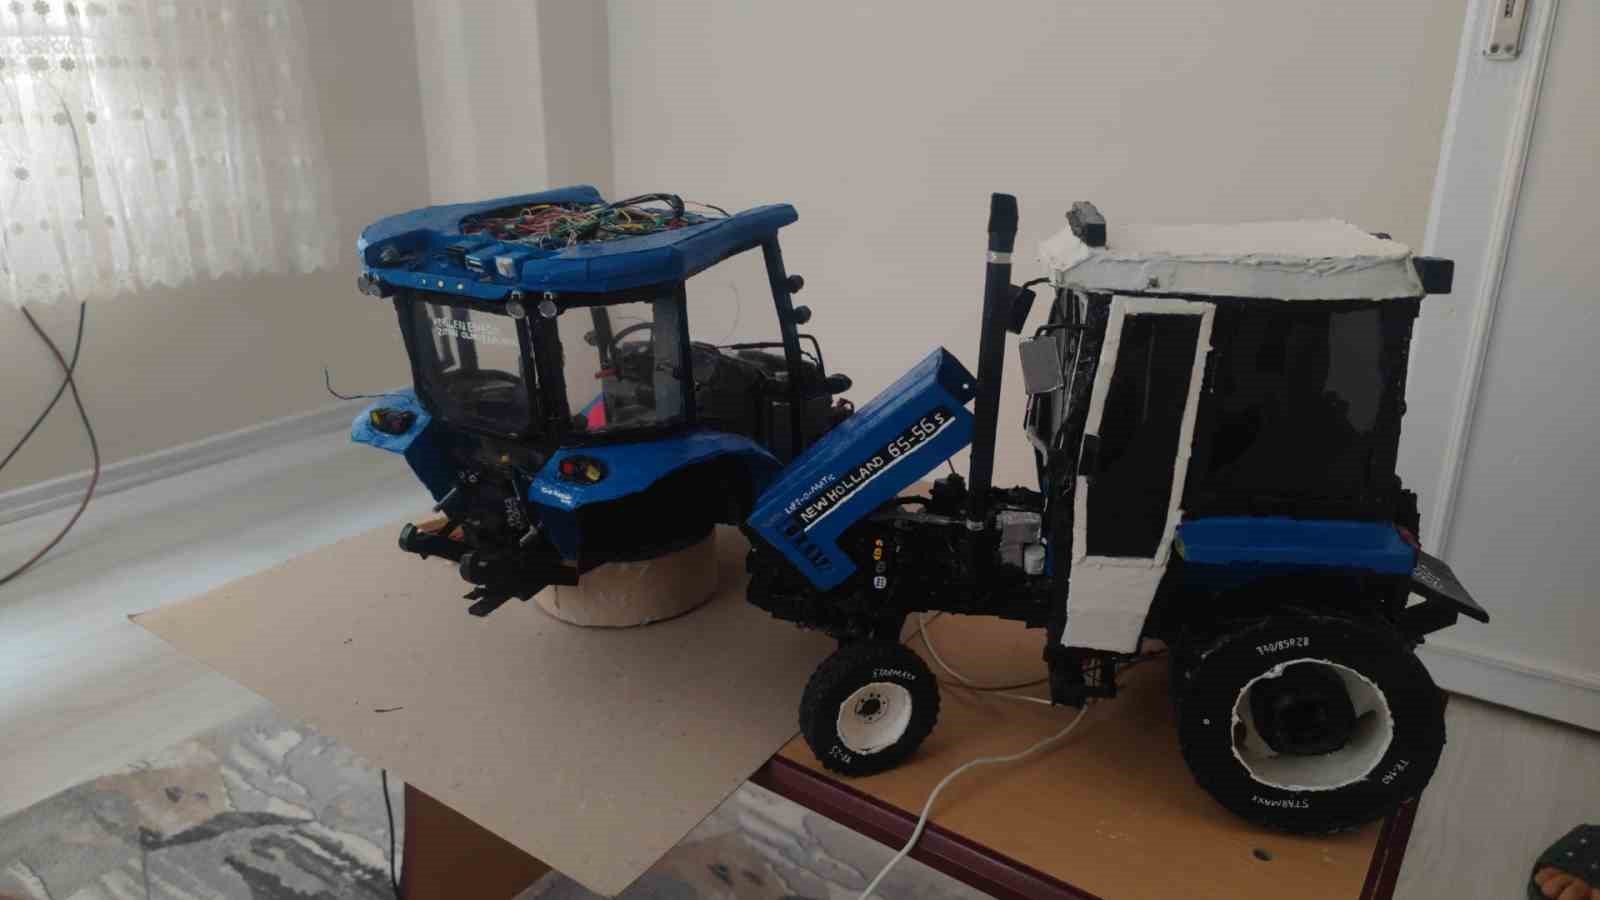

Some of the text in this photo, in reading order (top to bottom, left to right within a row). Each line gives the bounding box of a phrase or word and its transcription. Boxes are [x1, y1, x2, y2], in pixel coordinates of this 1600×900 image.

[800, 496, 829, 522] NEW
[826, 455, 884, 503] HOLLAND
[887, 417, 936, 458] 65-56
